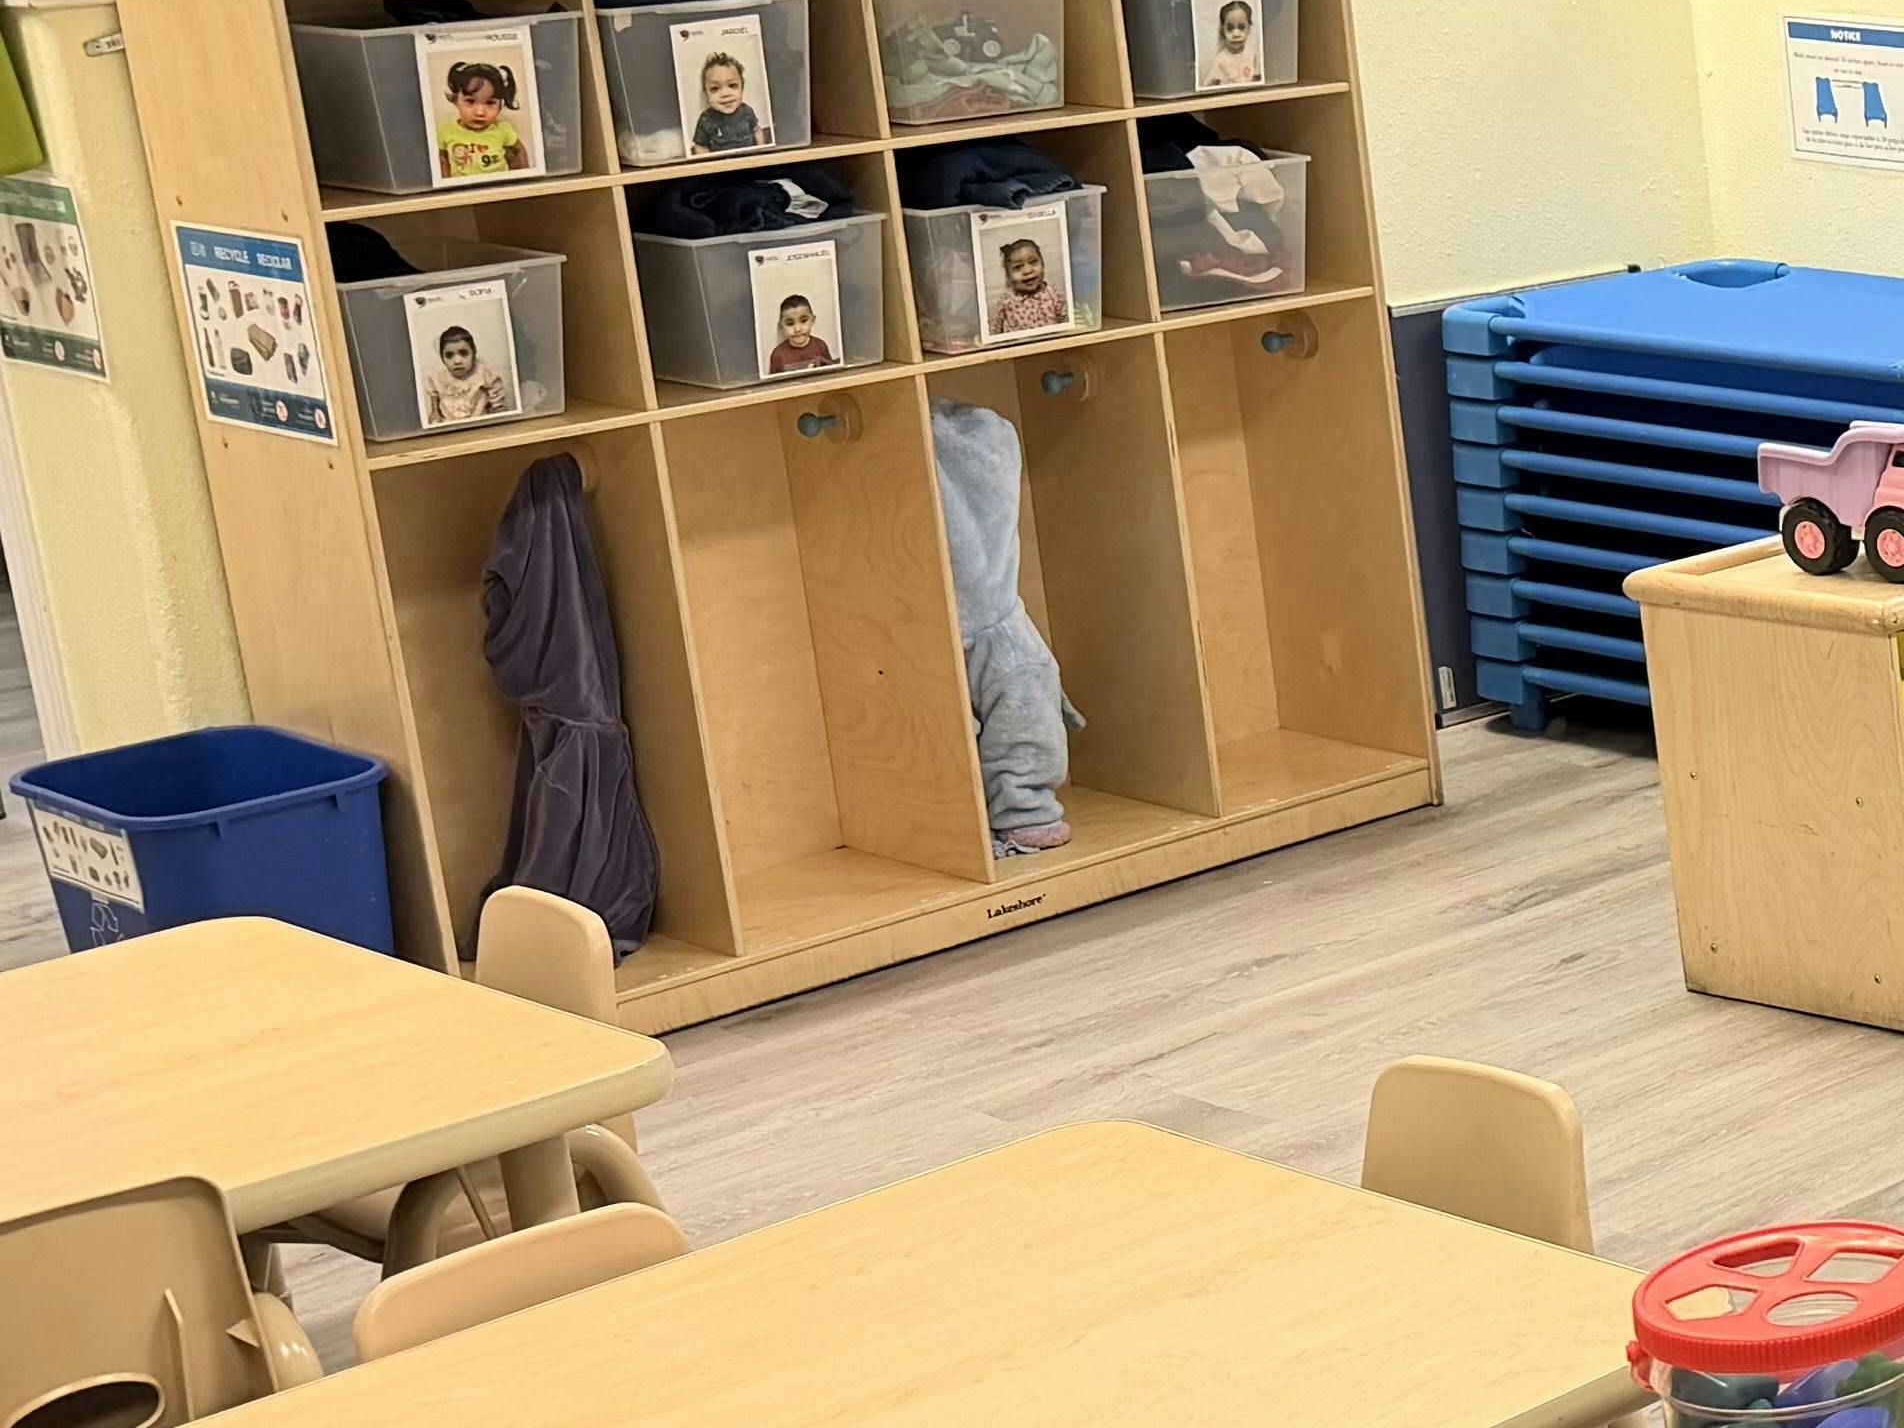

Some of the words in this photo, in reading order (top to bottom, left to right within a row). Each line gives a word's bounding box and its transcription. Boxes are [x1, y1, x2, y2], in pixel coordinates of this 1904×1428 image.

[1830, 28, 1861, 42] NOTICE
[213, 246, 249, 264] RECYCLE
[987, 893, 1046, 919] Lakeshore
